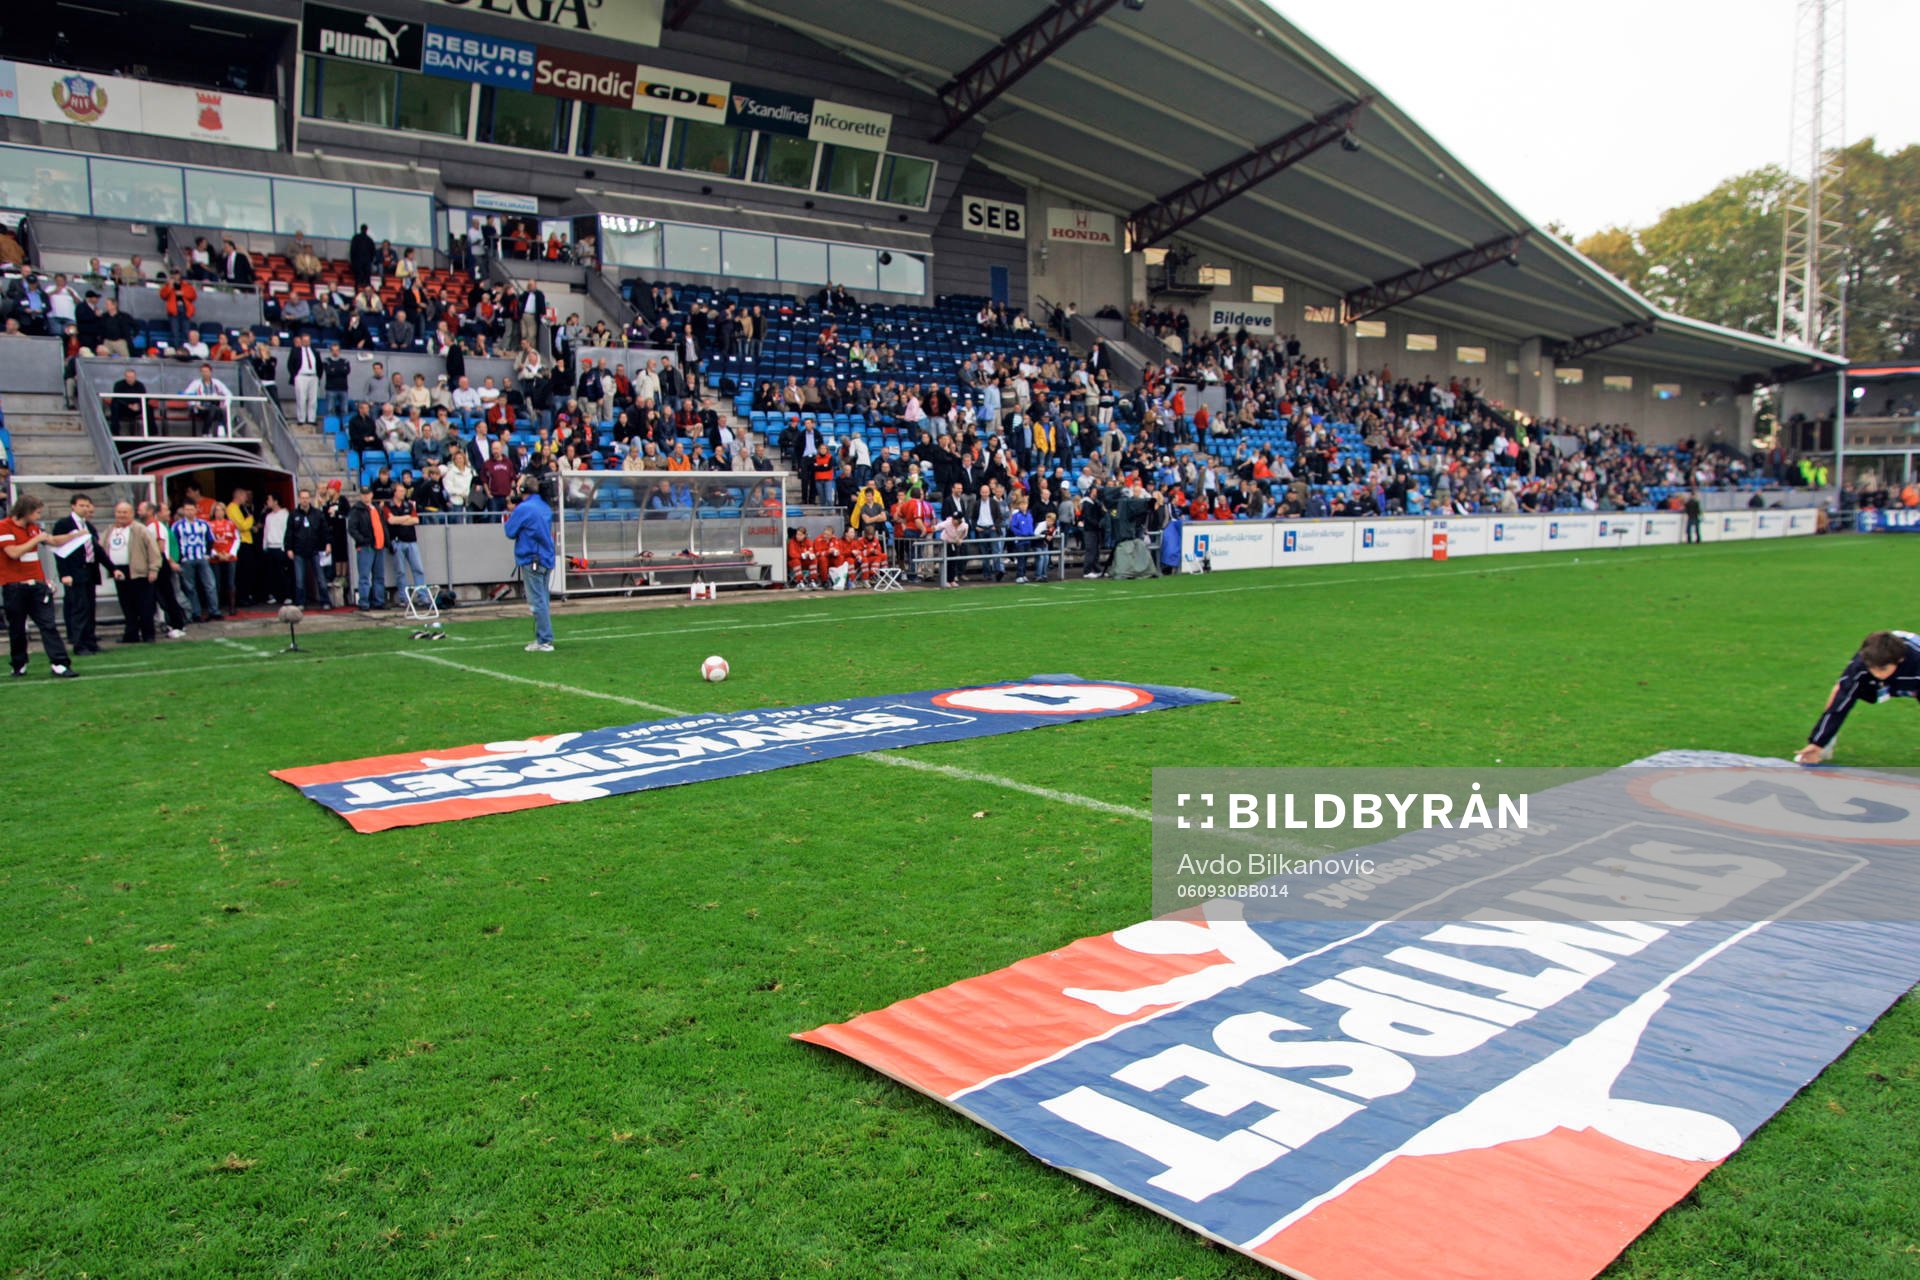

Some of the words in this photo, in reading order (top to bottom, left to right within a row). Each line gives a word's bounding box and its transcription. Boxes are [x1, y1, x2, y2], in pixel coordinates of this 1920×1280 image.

[320, 28, 389, 62] PUMA
[427, 32, 534, 65] RESURS
[425, 52, 489, 75] BANK
[536, 61, 632, 99] Scandic
[645, 83, 718, 109] GDL
[748, 101, 809, 125] Scandlines
[814, 112, 886, 138] nicorette
[968, 203, 1021, 232] SEB
[1051, 227, 1111, 242] HONDA
[1212, 310, 1273, 328] Bildeve
[345, 712, 919, 806] STRYKTIPSET
[1711, 778, 1910, 824] 2
[1038, 838, 1788, 1203] STRYKTIPSET
